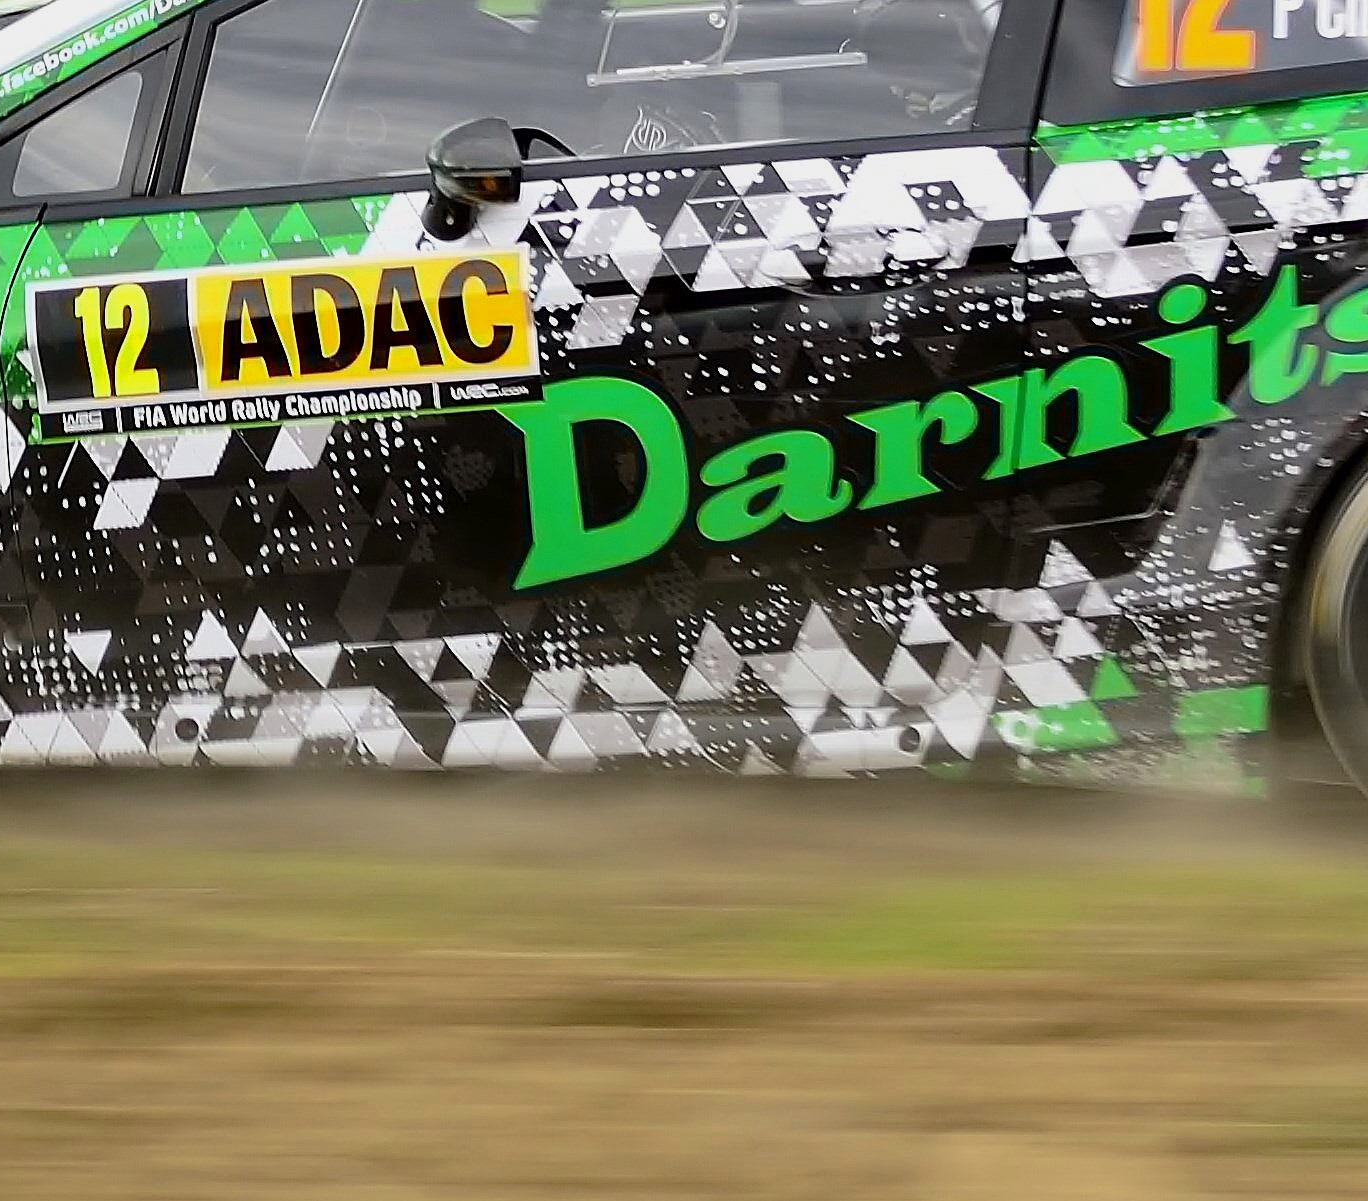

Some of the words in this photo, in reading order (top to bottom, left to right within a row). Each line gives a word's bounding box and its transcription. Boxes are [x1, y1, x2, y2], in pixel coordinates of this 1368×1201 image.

[74, 283, 160, 398] 12
[220, 259, 514, 383] ADAC
[133, 404, 167, 429] FIA
[170, 400, 228, 426] World
[232, 397, 281, 422] Rally
[285, 385, 423, 417] Championship
